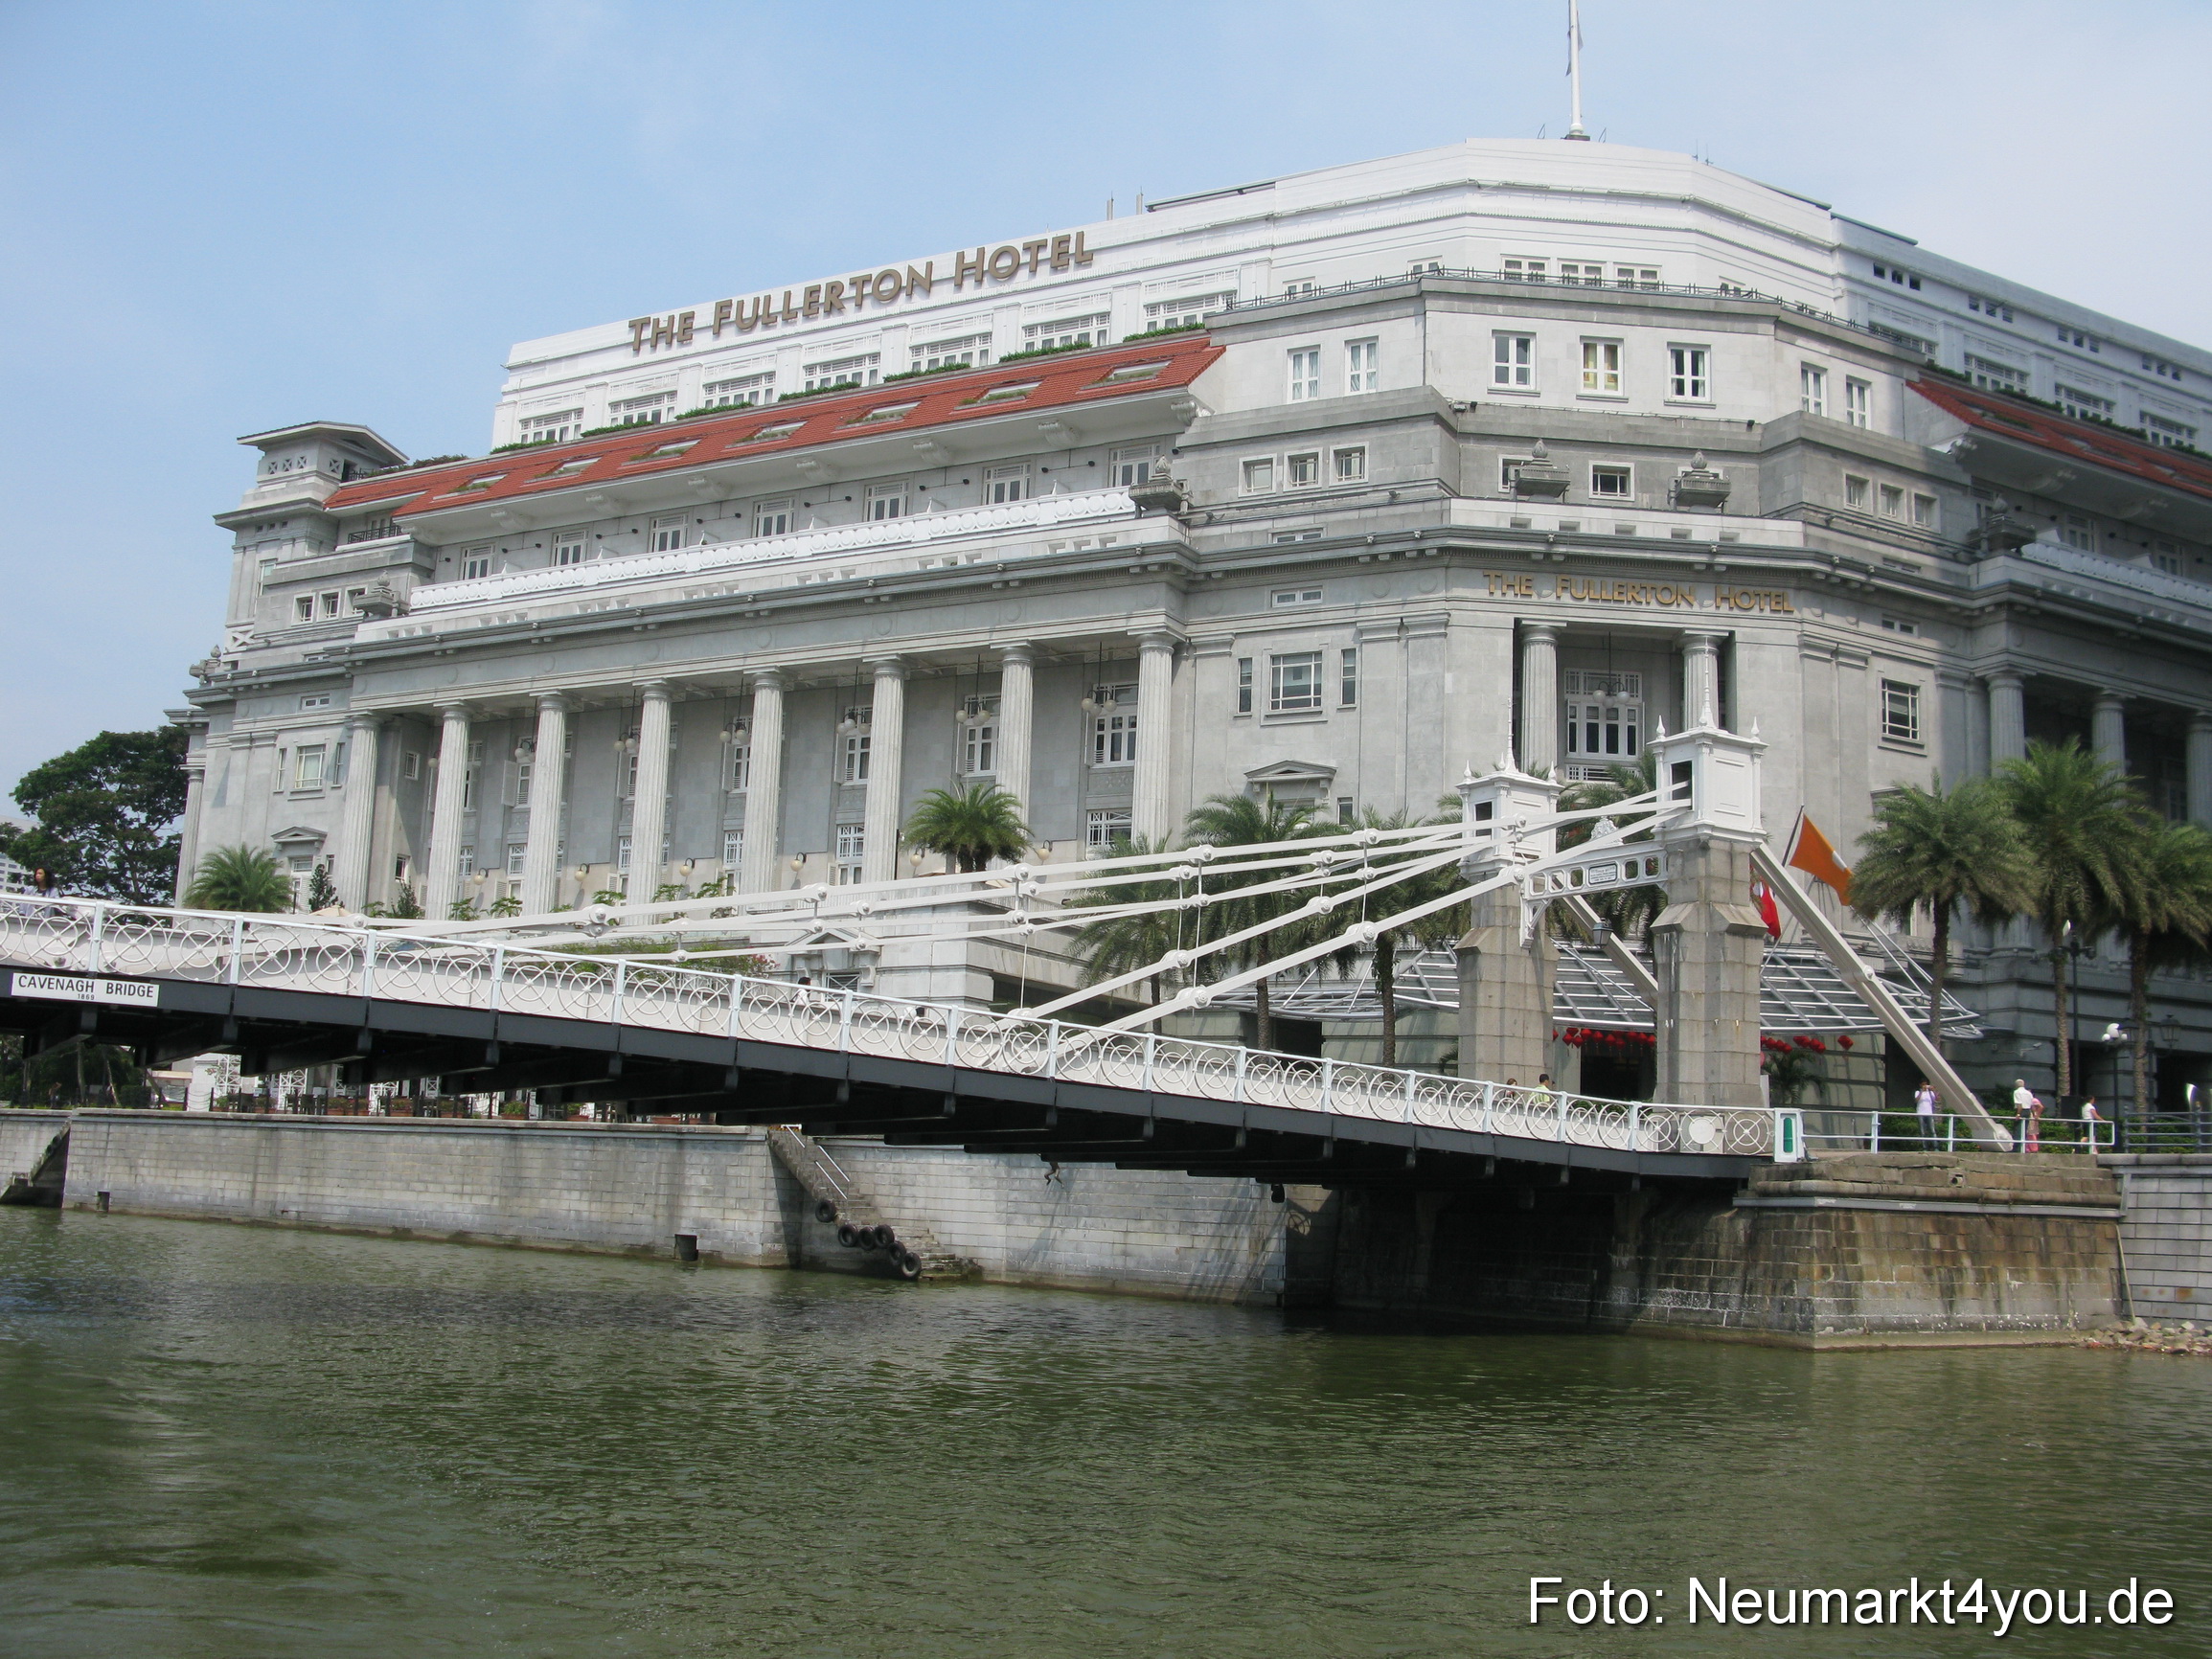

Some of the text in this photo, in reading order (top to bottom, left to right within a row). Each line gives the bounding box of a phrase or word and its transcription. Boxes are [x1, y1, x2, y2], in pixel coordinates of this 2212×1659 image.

[627, 230, 1094, 352] THE FULLERTON HOTEL
[1483, 570, 1795, 613] THE FULLERTON HOTEL
[18, 974, 154, 998] CAVENAGH BRIDGE
[77, 992, 95, 1001] 1869
